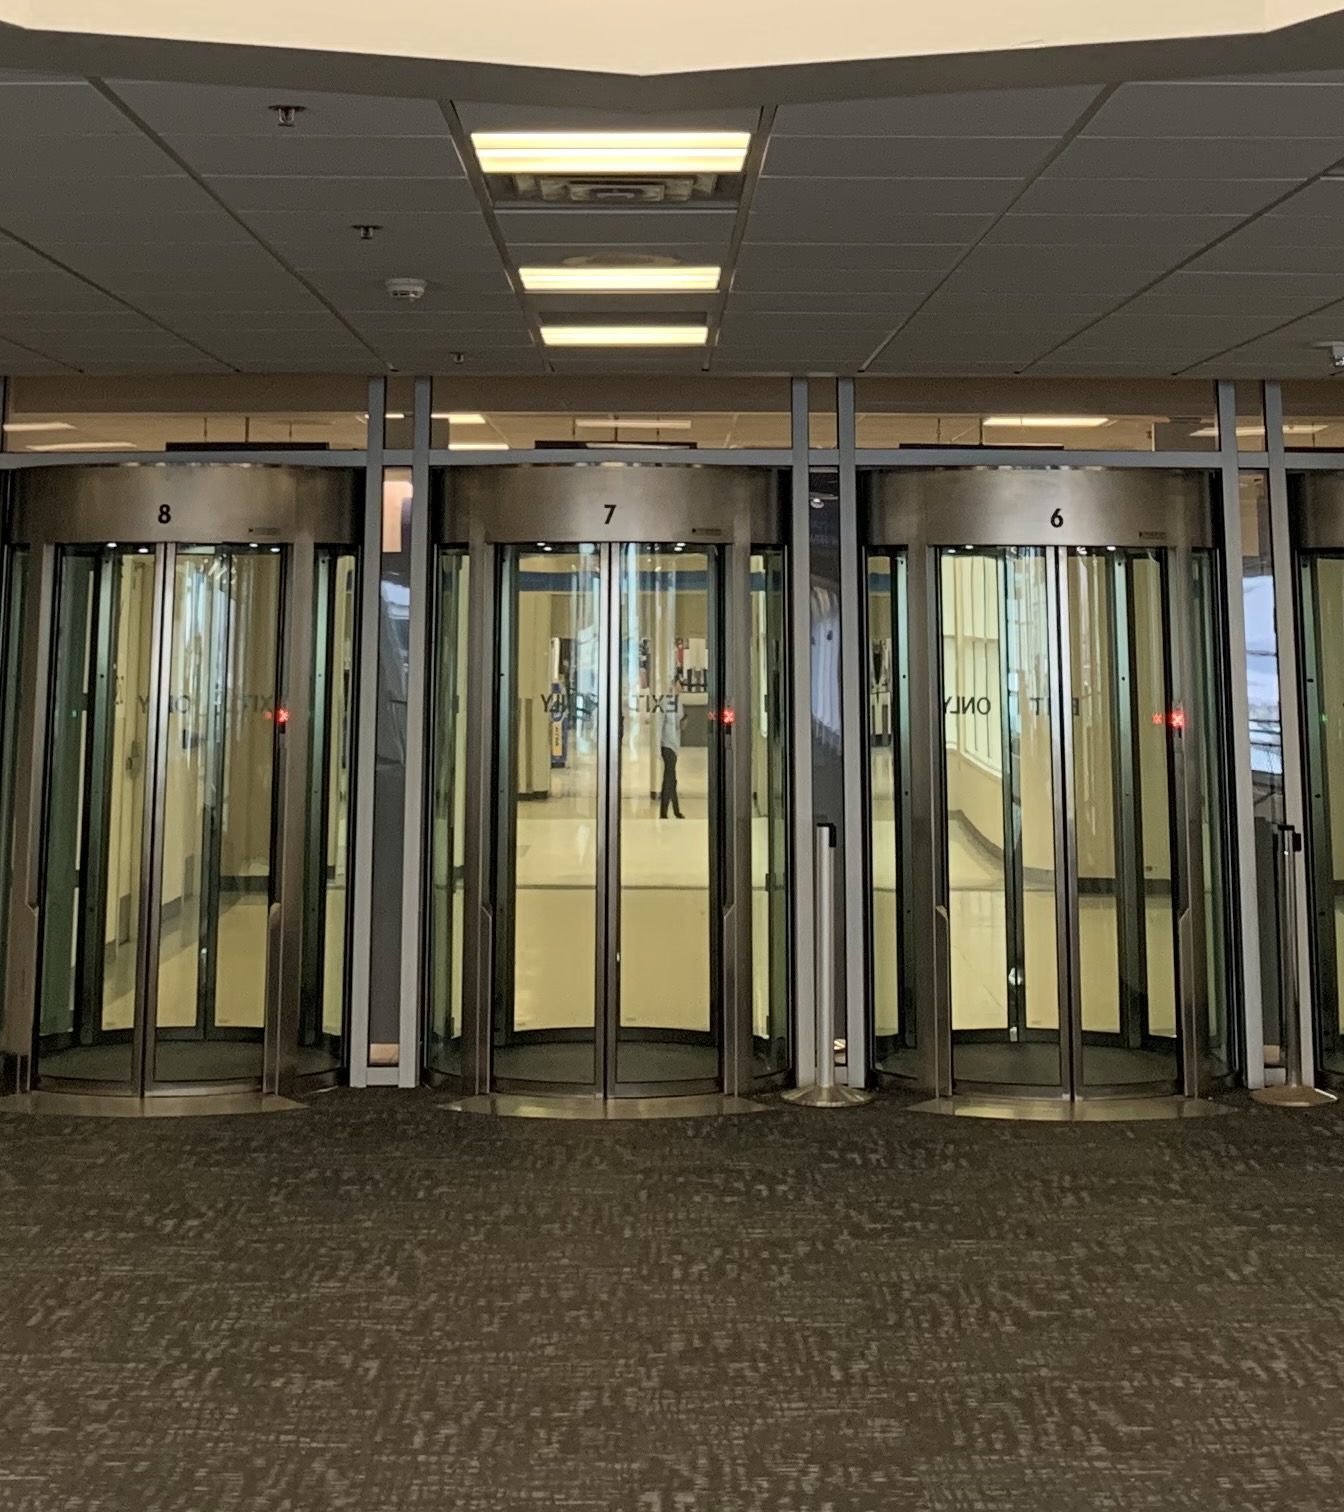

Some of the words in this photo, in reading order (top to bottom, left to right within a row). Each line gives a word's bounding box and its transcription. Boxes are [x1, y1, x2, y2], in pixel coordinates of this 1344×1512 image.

[158, 504, 171, 524] 8
[604, 504, 617, 524] 7
[1050, 508, 1064, 528] 6
